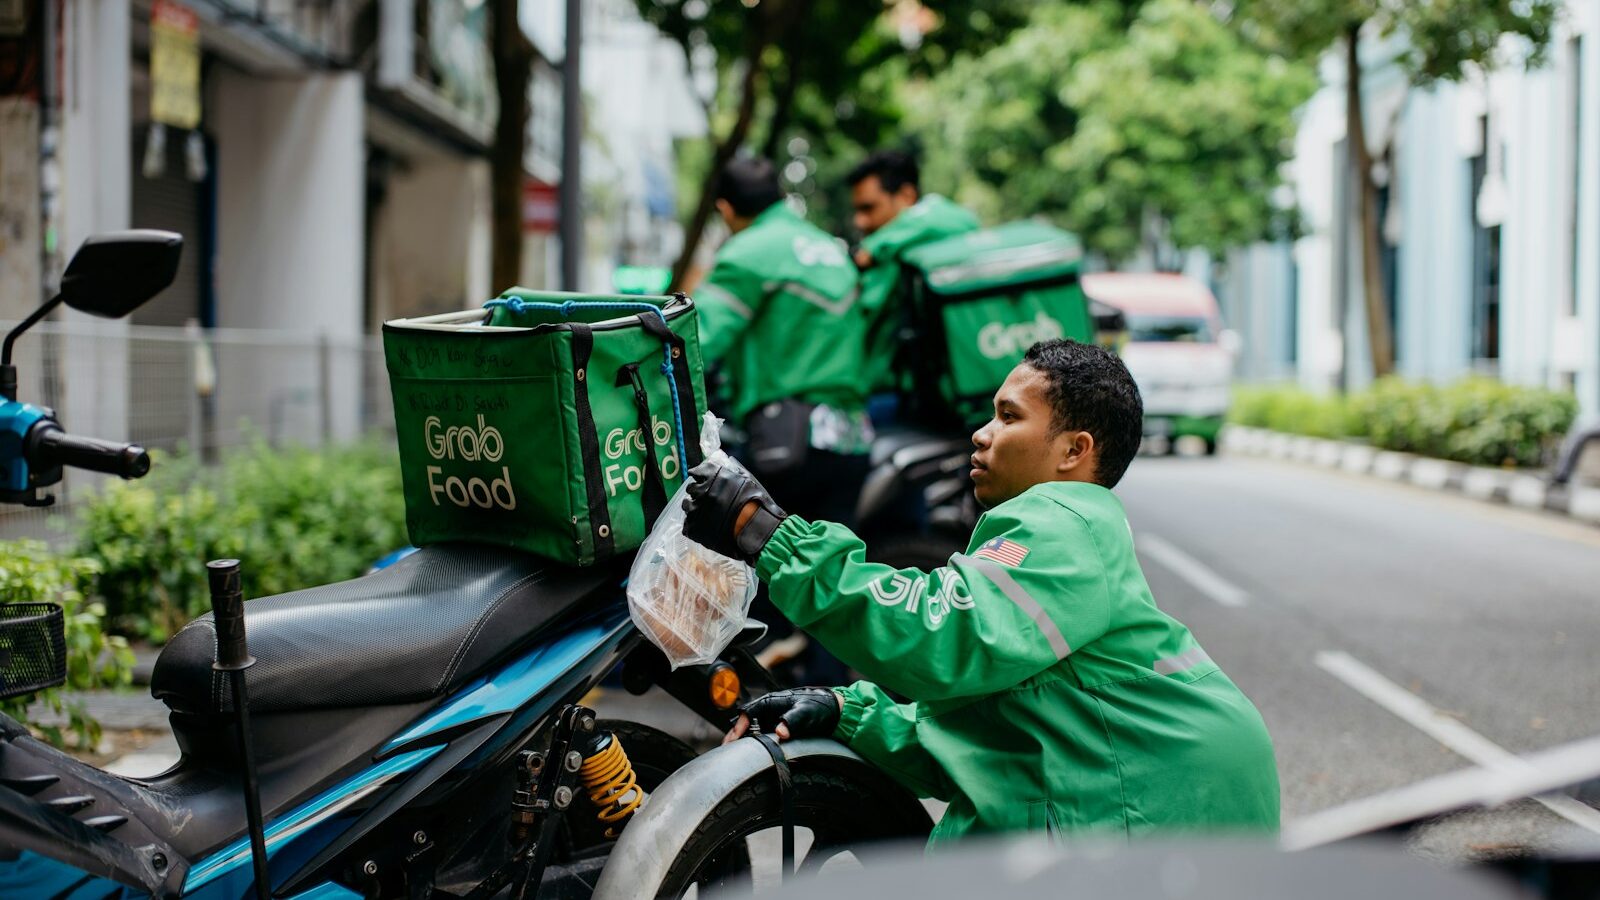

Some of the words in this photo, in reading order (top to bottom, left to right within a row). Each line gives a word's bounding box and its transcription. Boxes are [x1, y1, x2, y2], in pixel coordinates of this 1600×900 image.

[425, 414, 504, 462] Grab
[426, 465, 516, 510] Food
[605, 445, 680, 496] Fod
